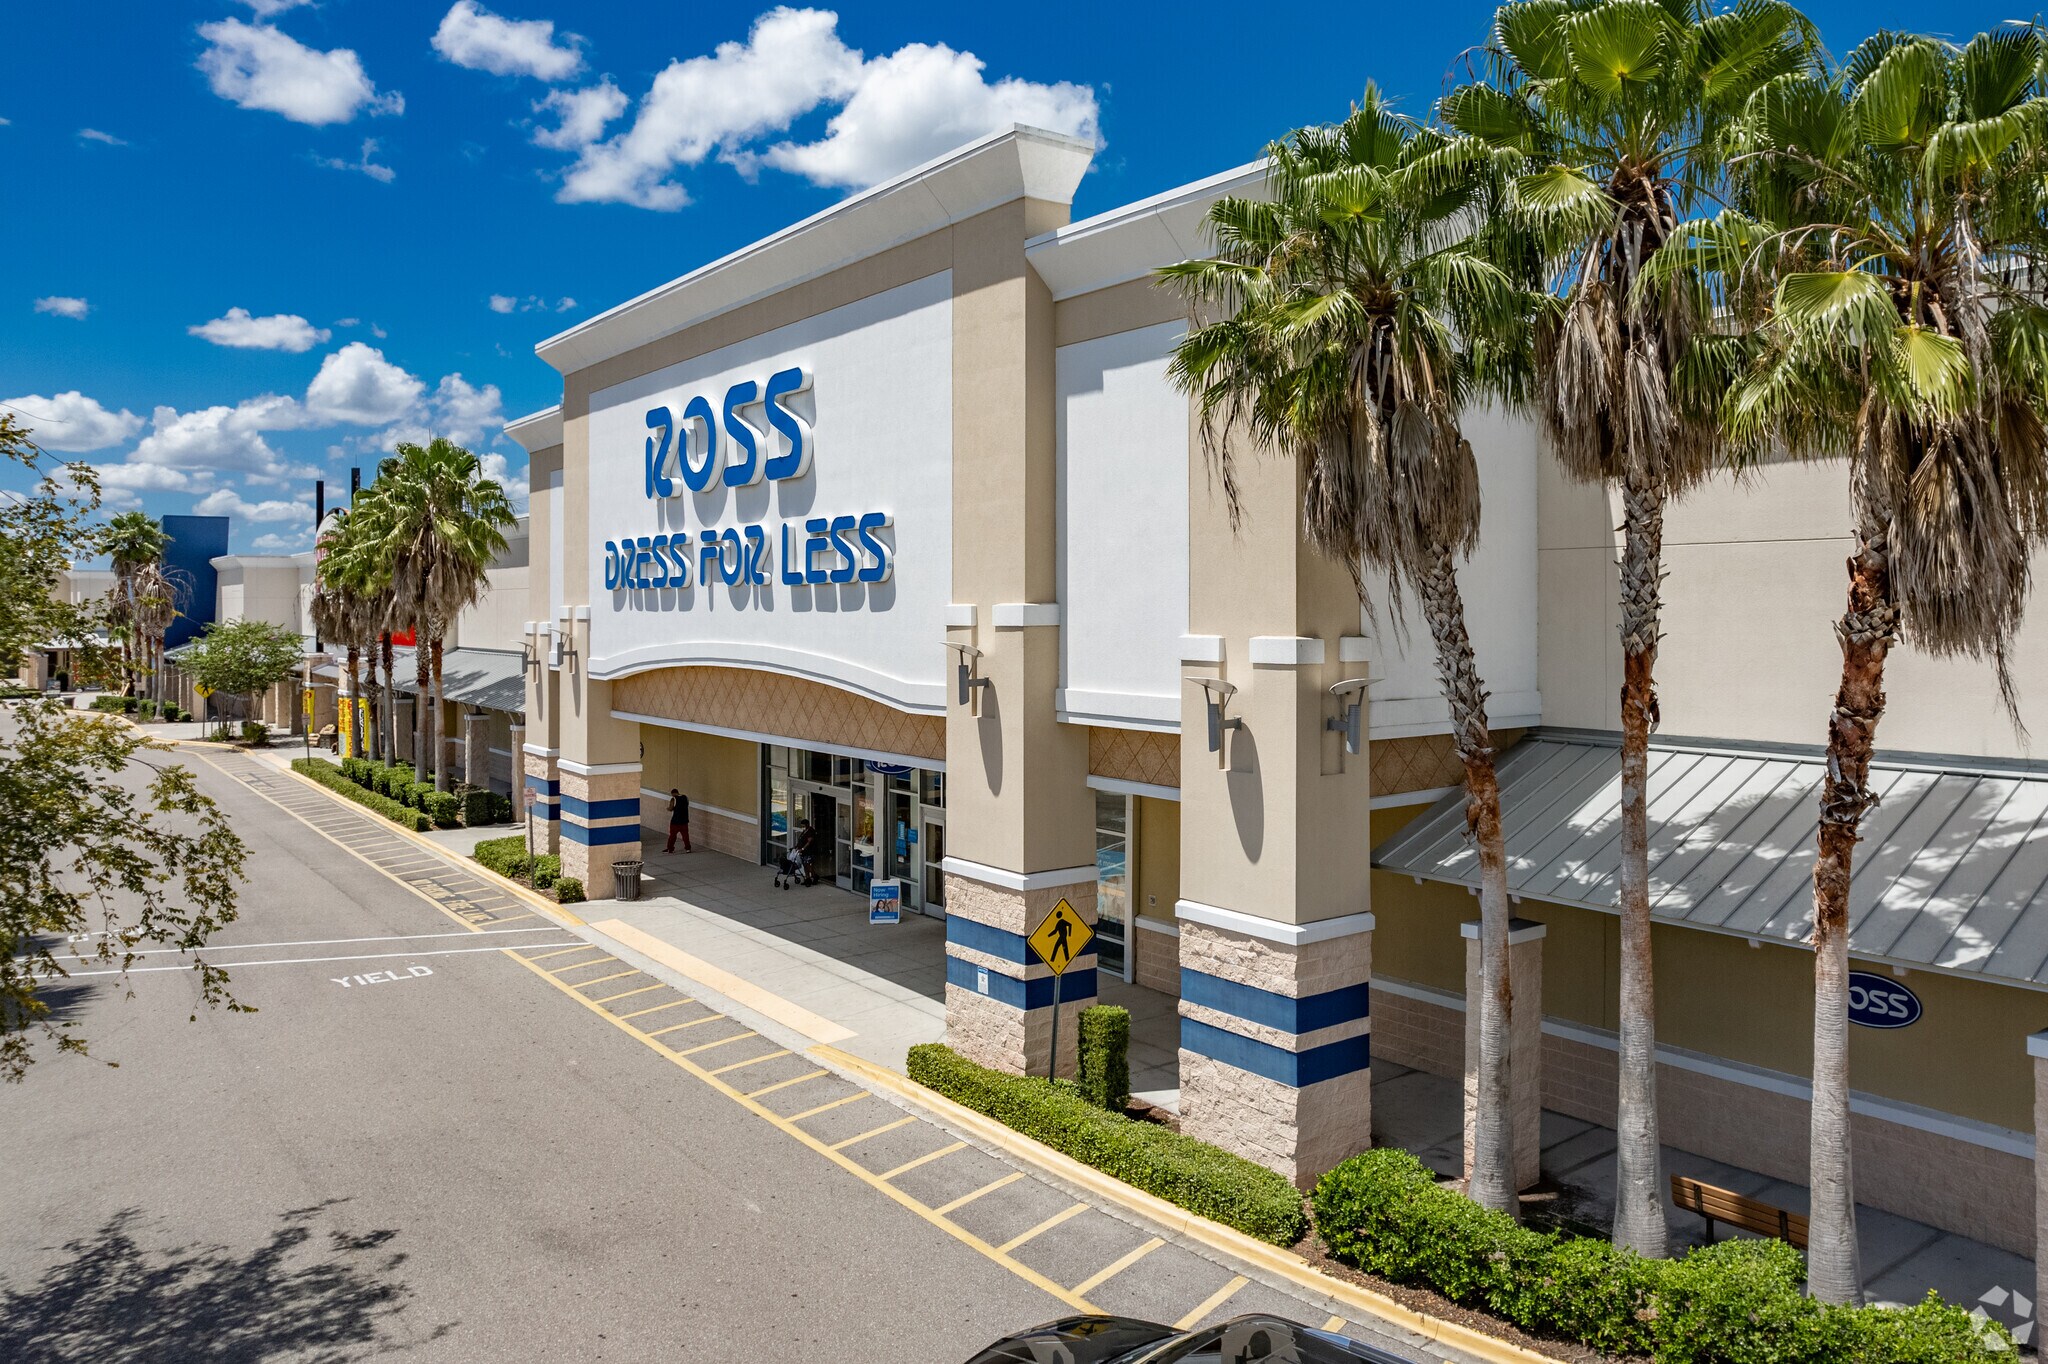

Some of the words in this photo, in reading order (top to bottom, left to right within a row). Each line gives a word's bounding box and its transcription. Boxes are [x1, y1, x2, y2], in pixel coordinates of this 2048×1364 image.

[646, 367, 803, 499] ROSS
[605, 533, 687, 590] DRESS
[700, 525, 765, 586] FOR
[782, 512, 886, 586] LESS
[330, 966, 433, 988] YIELD
[1848, 986, 1908, 1019] OSS
